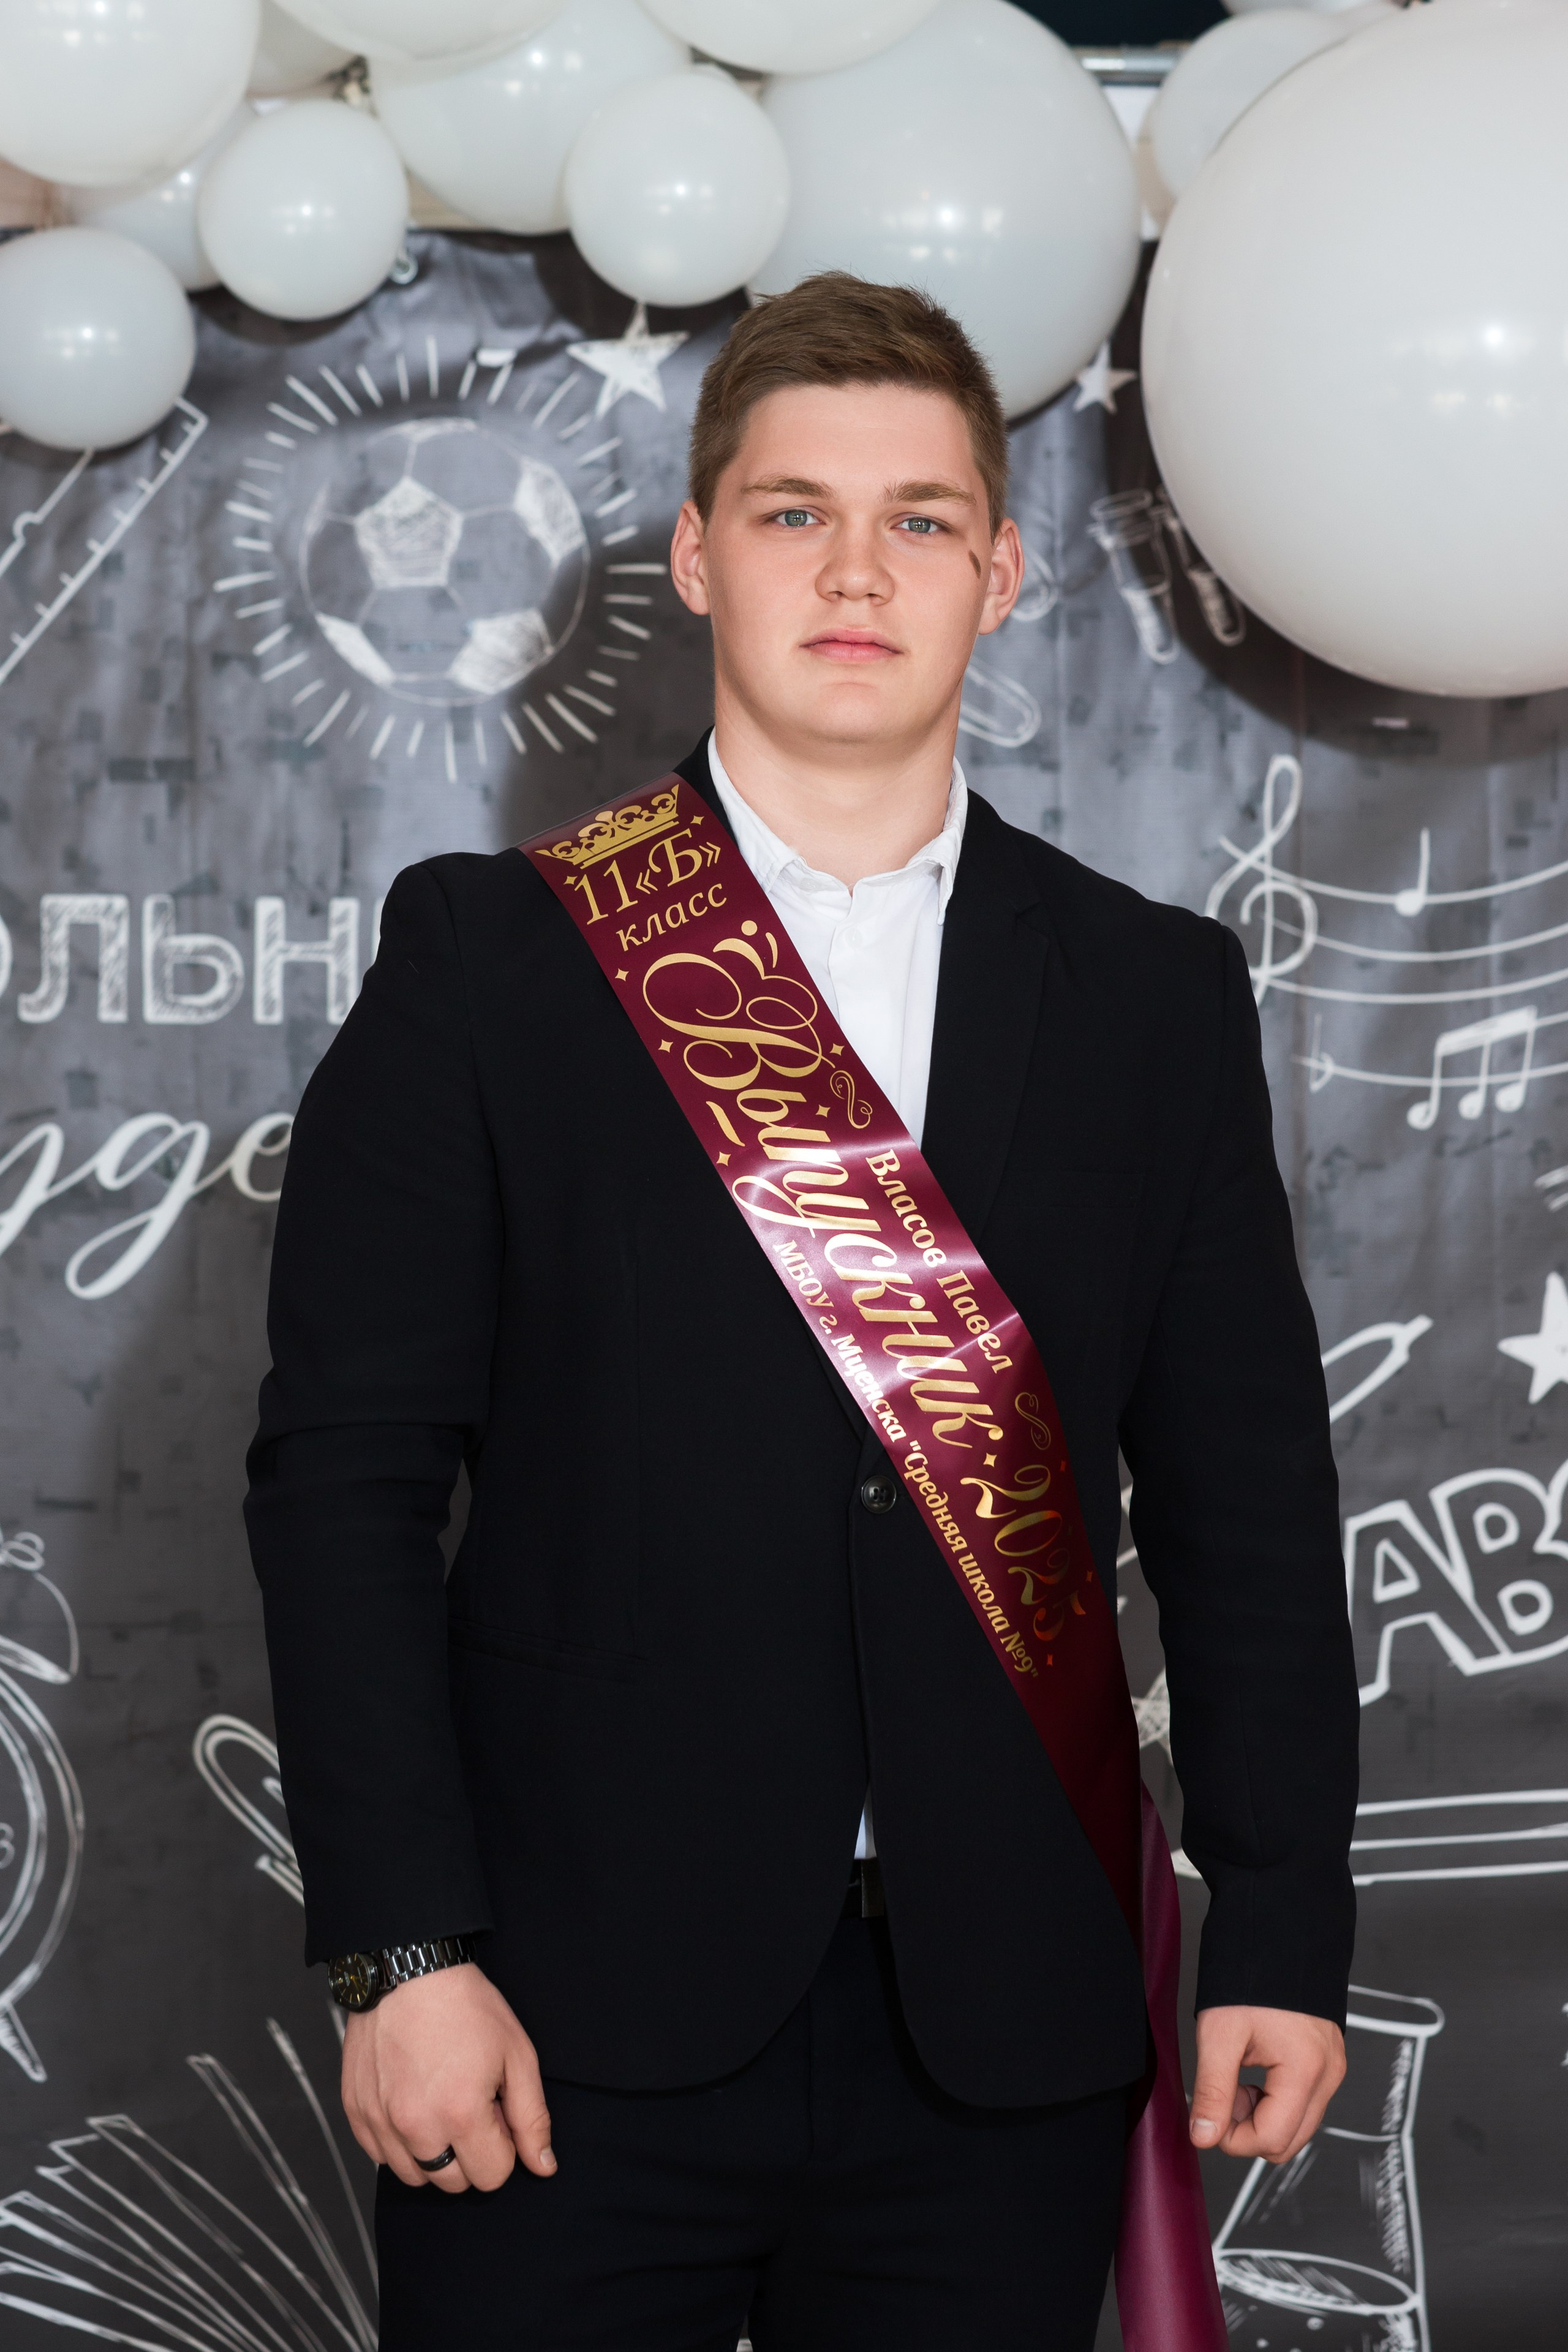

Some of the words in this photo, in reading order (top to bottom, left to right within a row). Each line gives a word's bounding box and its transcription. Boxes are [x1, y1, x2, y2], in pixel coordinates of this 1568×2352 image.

[0, 892, 381, 1025] ЛЬН
[616, 883, 727, 952] класс
[643, 920, 1004, 1449] Выпускник
[960, 1464, 1086, 1642] 2025
[865, 1148, 948, 1269] Власов
[936, 1270, 1014, 1374] Павел
[773, 1239, 835, 1308] МБОУ
[819, 1314, 839, 1335] г.
[831, 1333, 907, 1444] Мценска
[903, 1439, 967, 1554] "Средняя
[957, 1552, 1011, 1635] школа
[1000, 1630, 1039, 1678] №9"
[1343, 1458, 1568, 1707] AB
